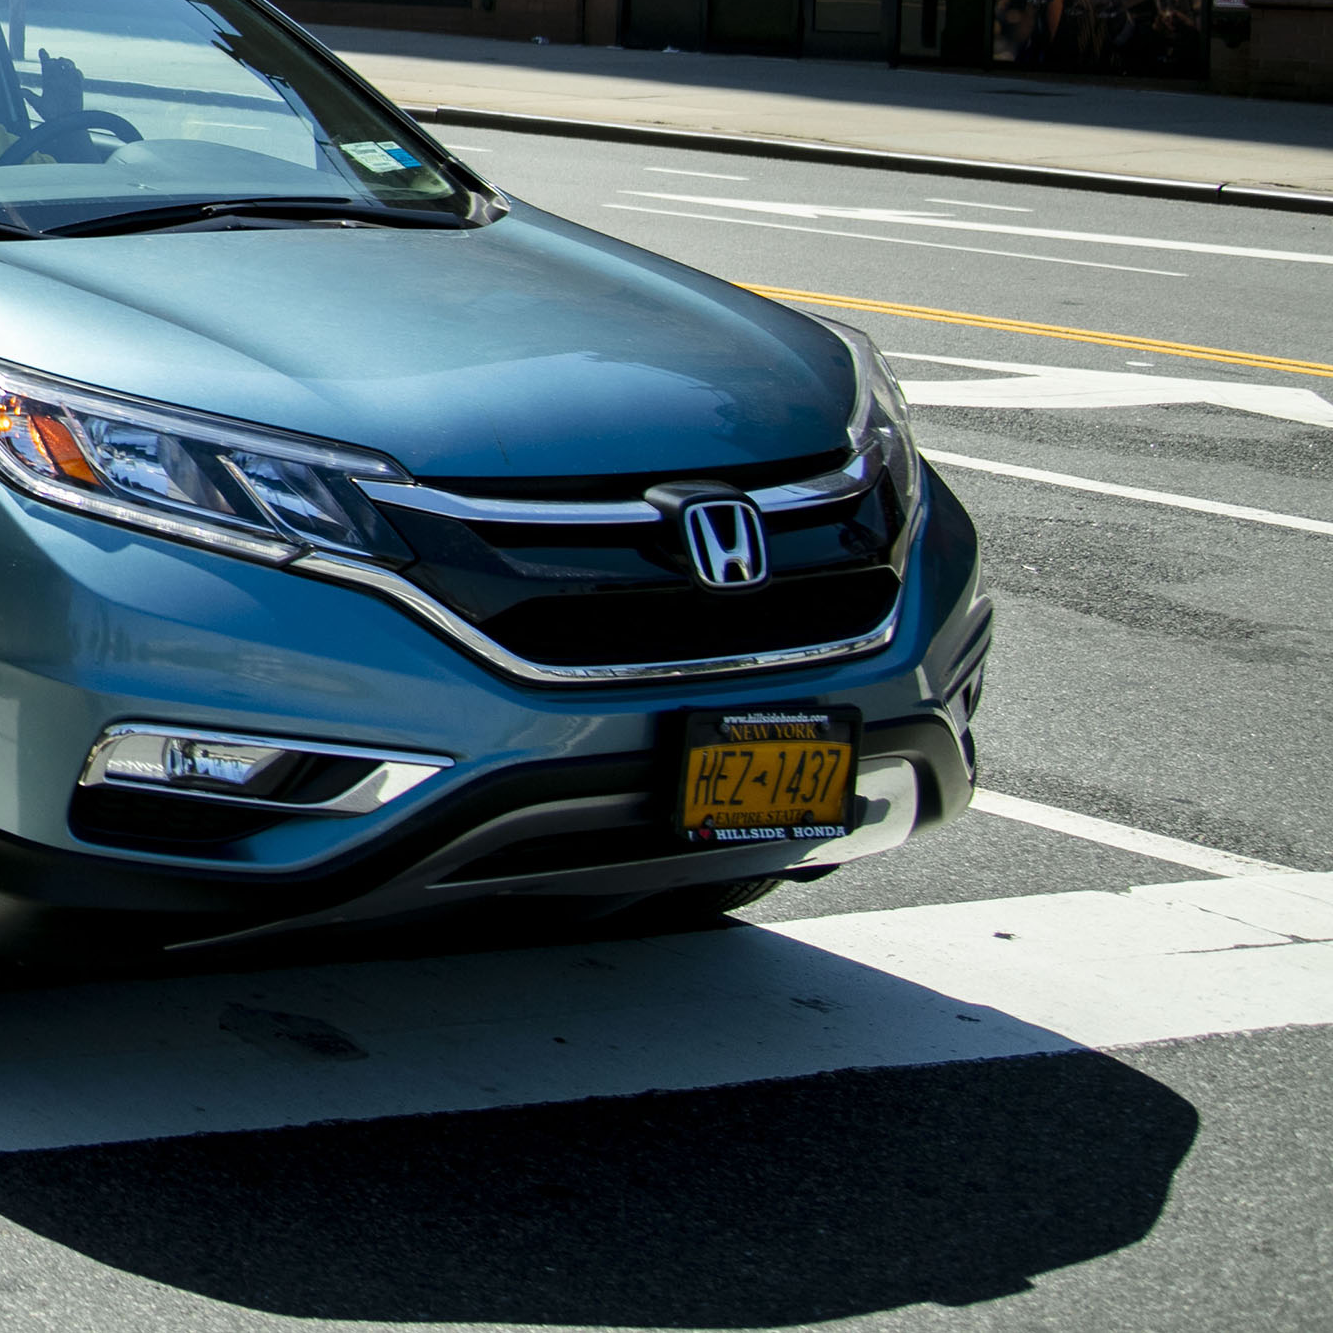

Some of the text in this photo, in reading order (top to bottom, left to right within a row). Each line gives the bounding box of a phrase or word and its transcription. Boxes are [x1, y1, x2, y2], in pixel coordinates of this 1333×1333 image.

[723, 712, 829, 724] www.hillsidehonda.com
[729, 723, 817, 741] NEW YORK
[693, 749, 841, 806] HEZ 1437
[715, 811, 764, 826] EMPIRE
[716, 827, 786, 840] HILLSIDE
[793, 825, 846, 837] HONDA
